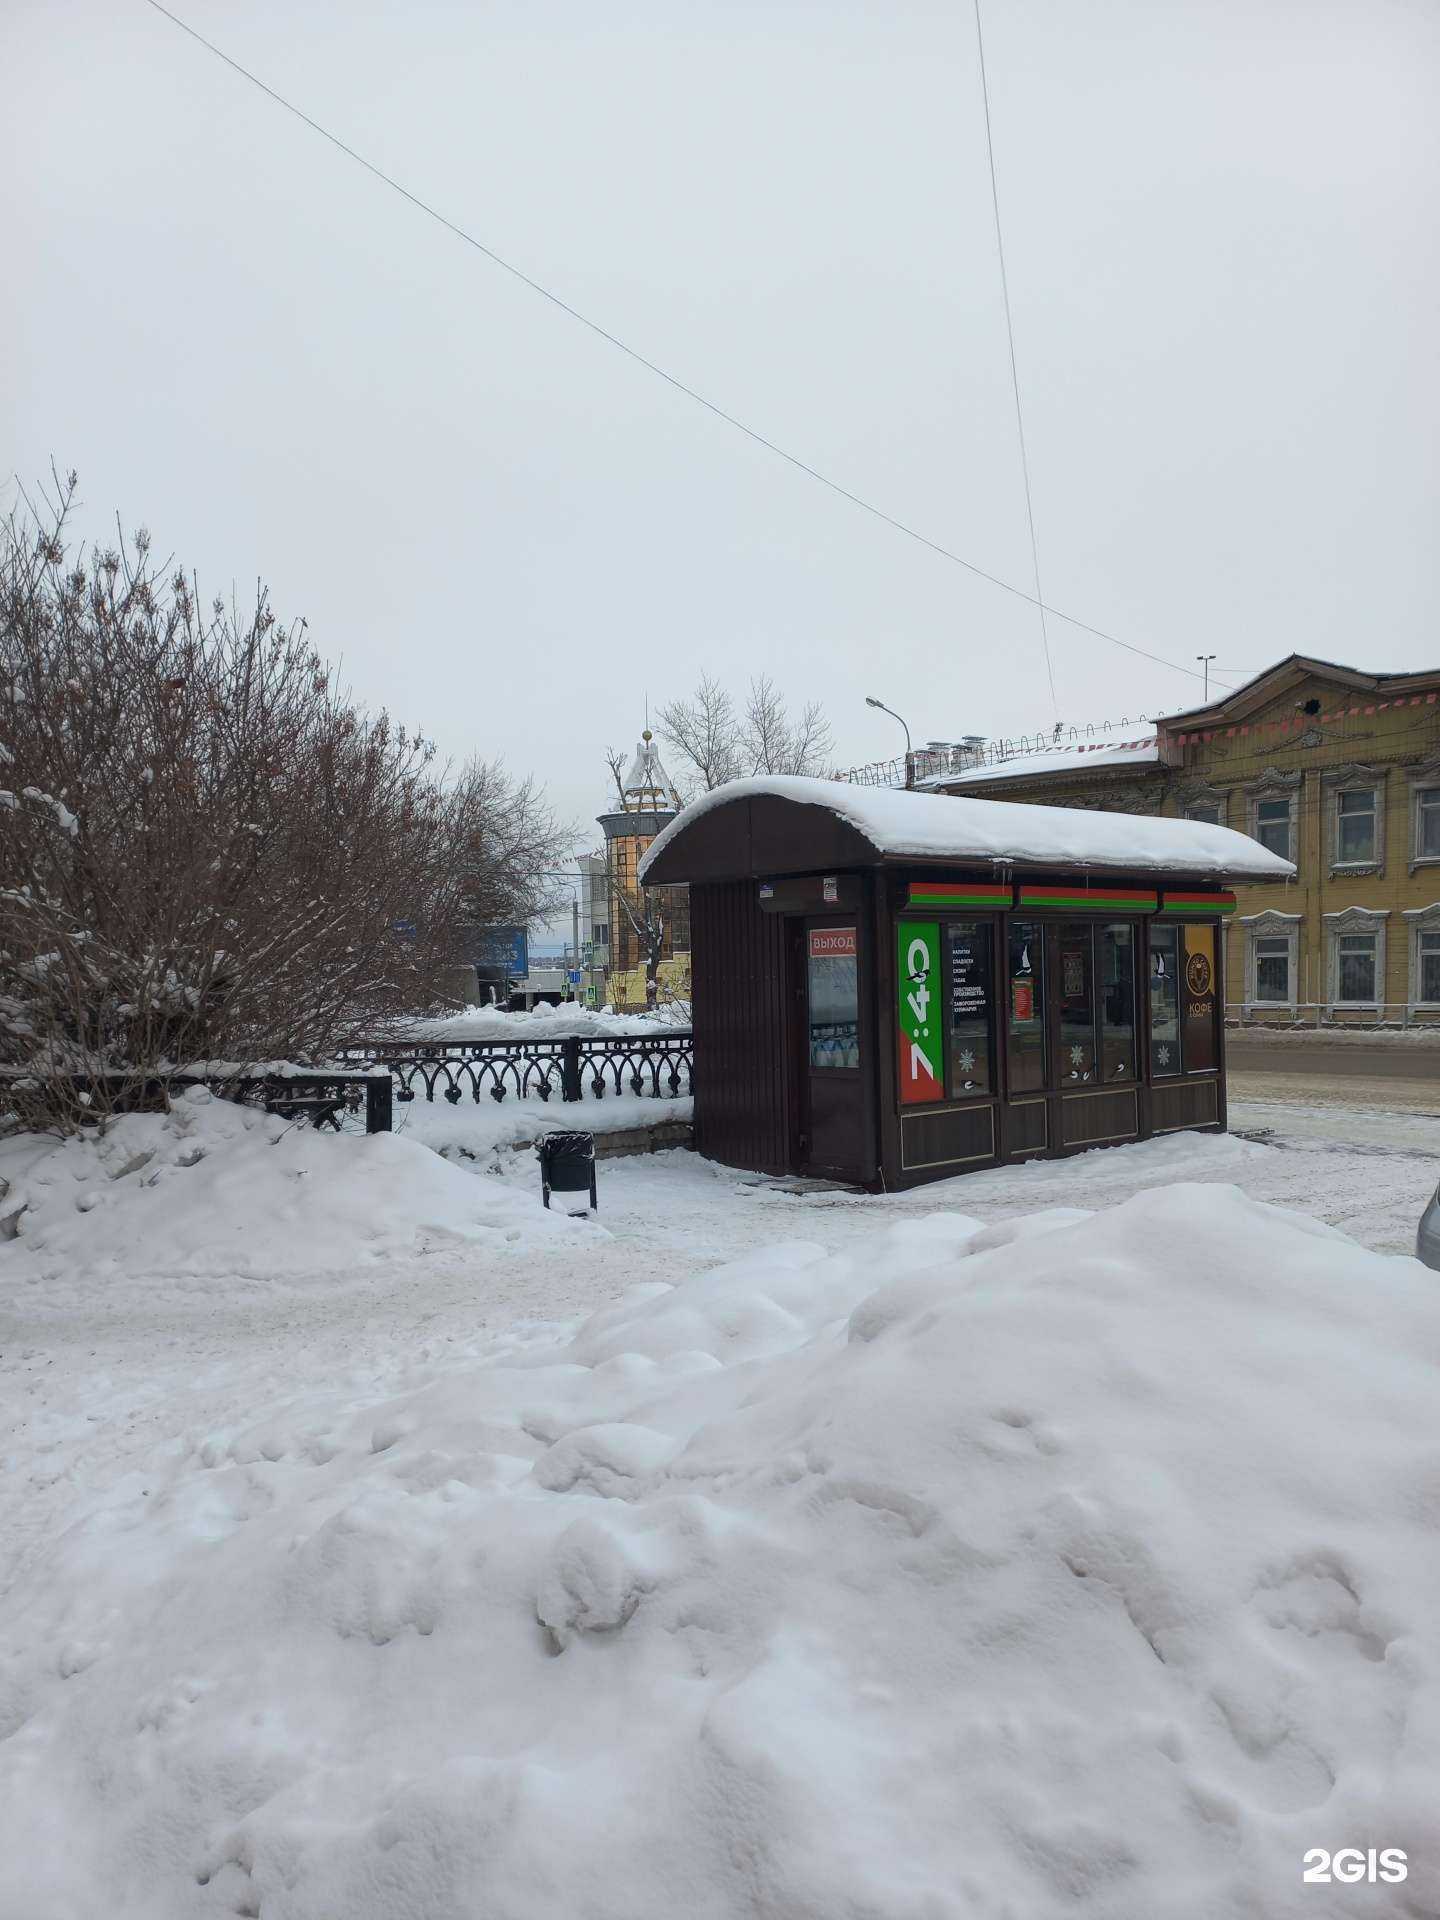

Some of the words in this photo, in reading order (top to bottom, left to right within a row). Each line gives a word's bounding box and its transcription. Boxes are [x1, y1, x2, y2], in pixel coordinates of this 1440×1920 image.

[813, 937, 855, 950] ВЫХОД
[906, 938, 934, 1081] 7:40
[1189, 1002, 1213, 1015] КОФЕ
